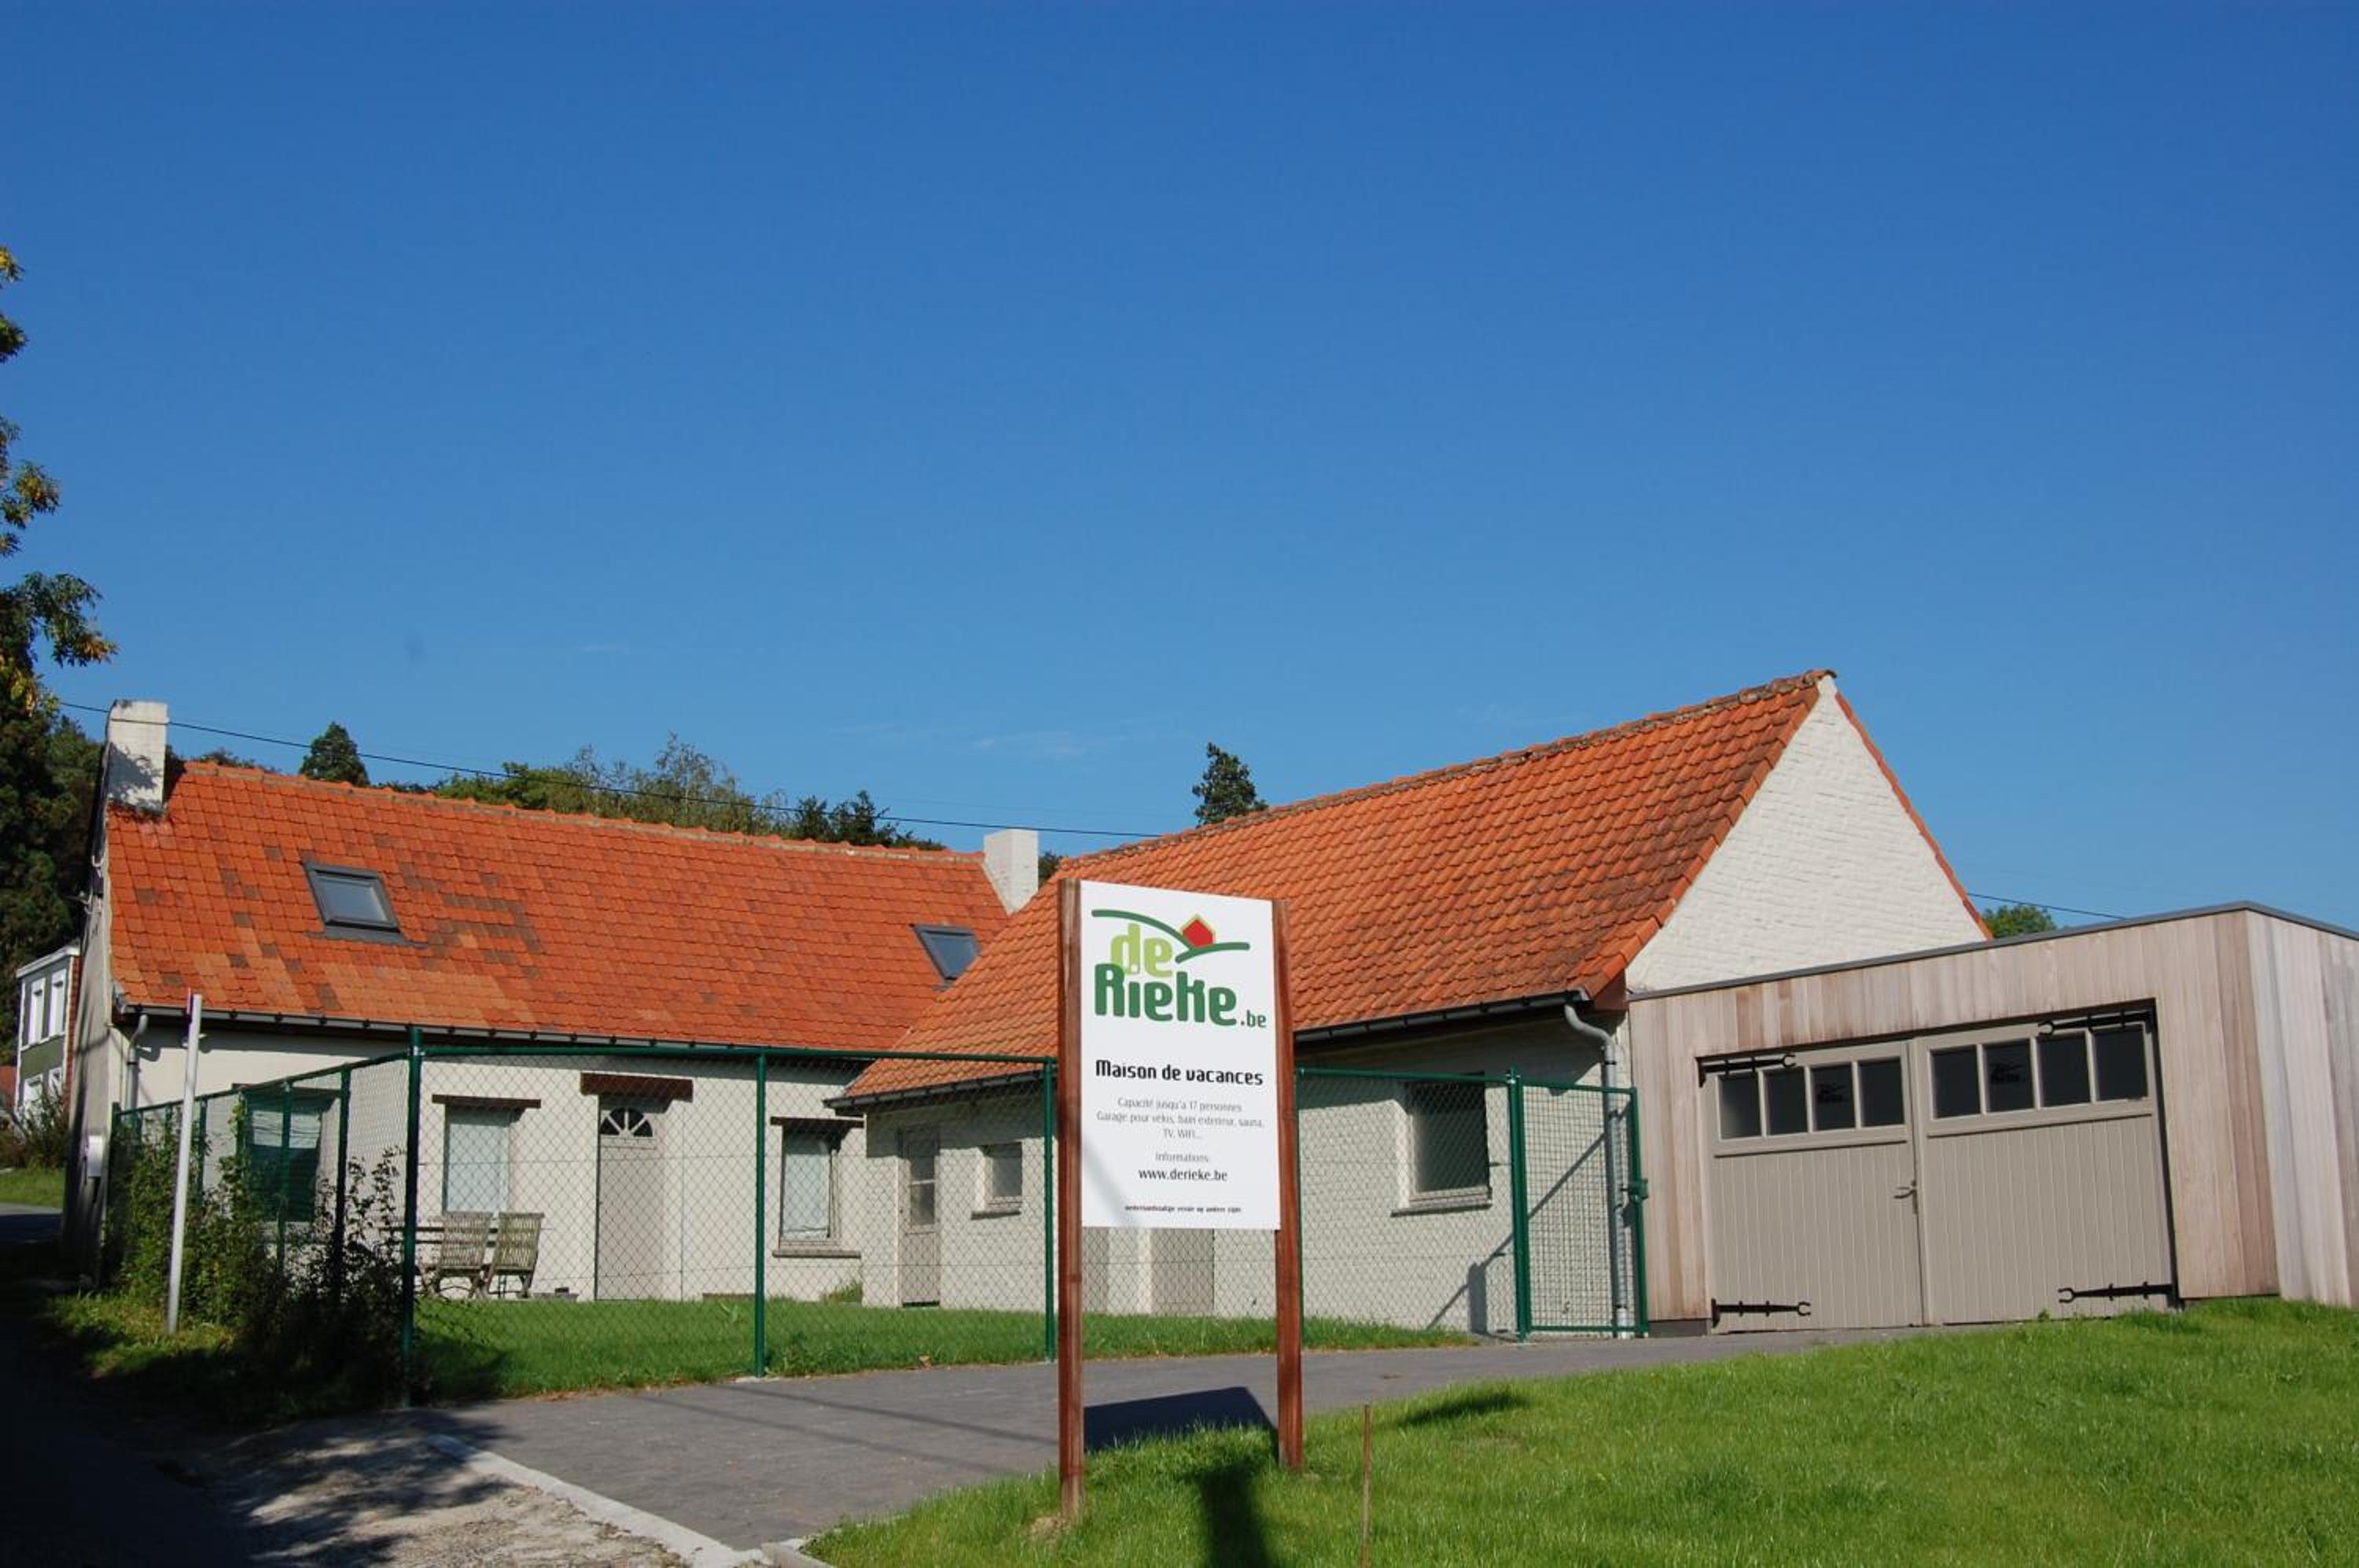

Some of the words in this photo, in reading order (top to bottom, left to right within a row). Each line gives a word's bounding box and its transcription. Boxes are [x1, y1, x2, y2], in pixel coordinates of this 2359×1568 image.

[1110, 922, 1172, 977] de
[1095, 1059, 1157, 1079] Maison
[1161, 1065, 1182, 1080] de
[1186, 1069, 1264, 1085] vacances
[1190, 1100, 1198, 1110] 17
[1199, 1102, 1242, 1113] personnes
[1096, 1110, 1128, 1123] Garage
[1130, 1113, 1149, 1124] pour
[1177, 1114, 1196, 1124] bain
[1139, 1167, 1227, 1182] www.derieke.be
